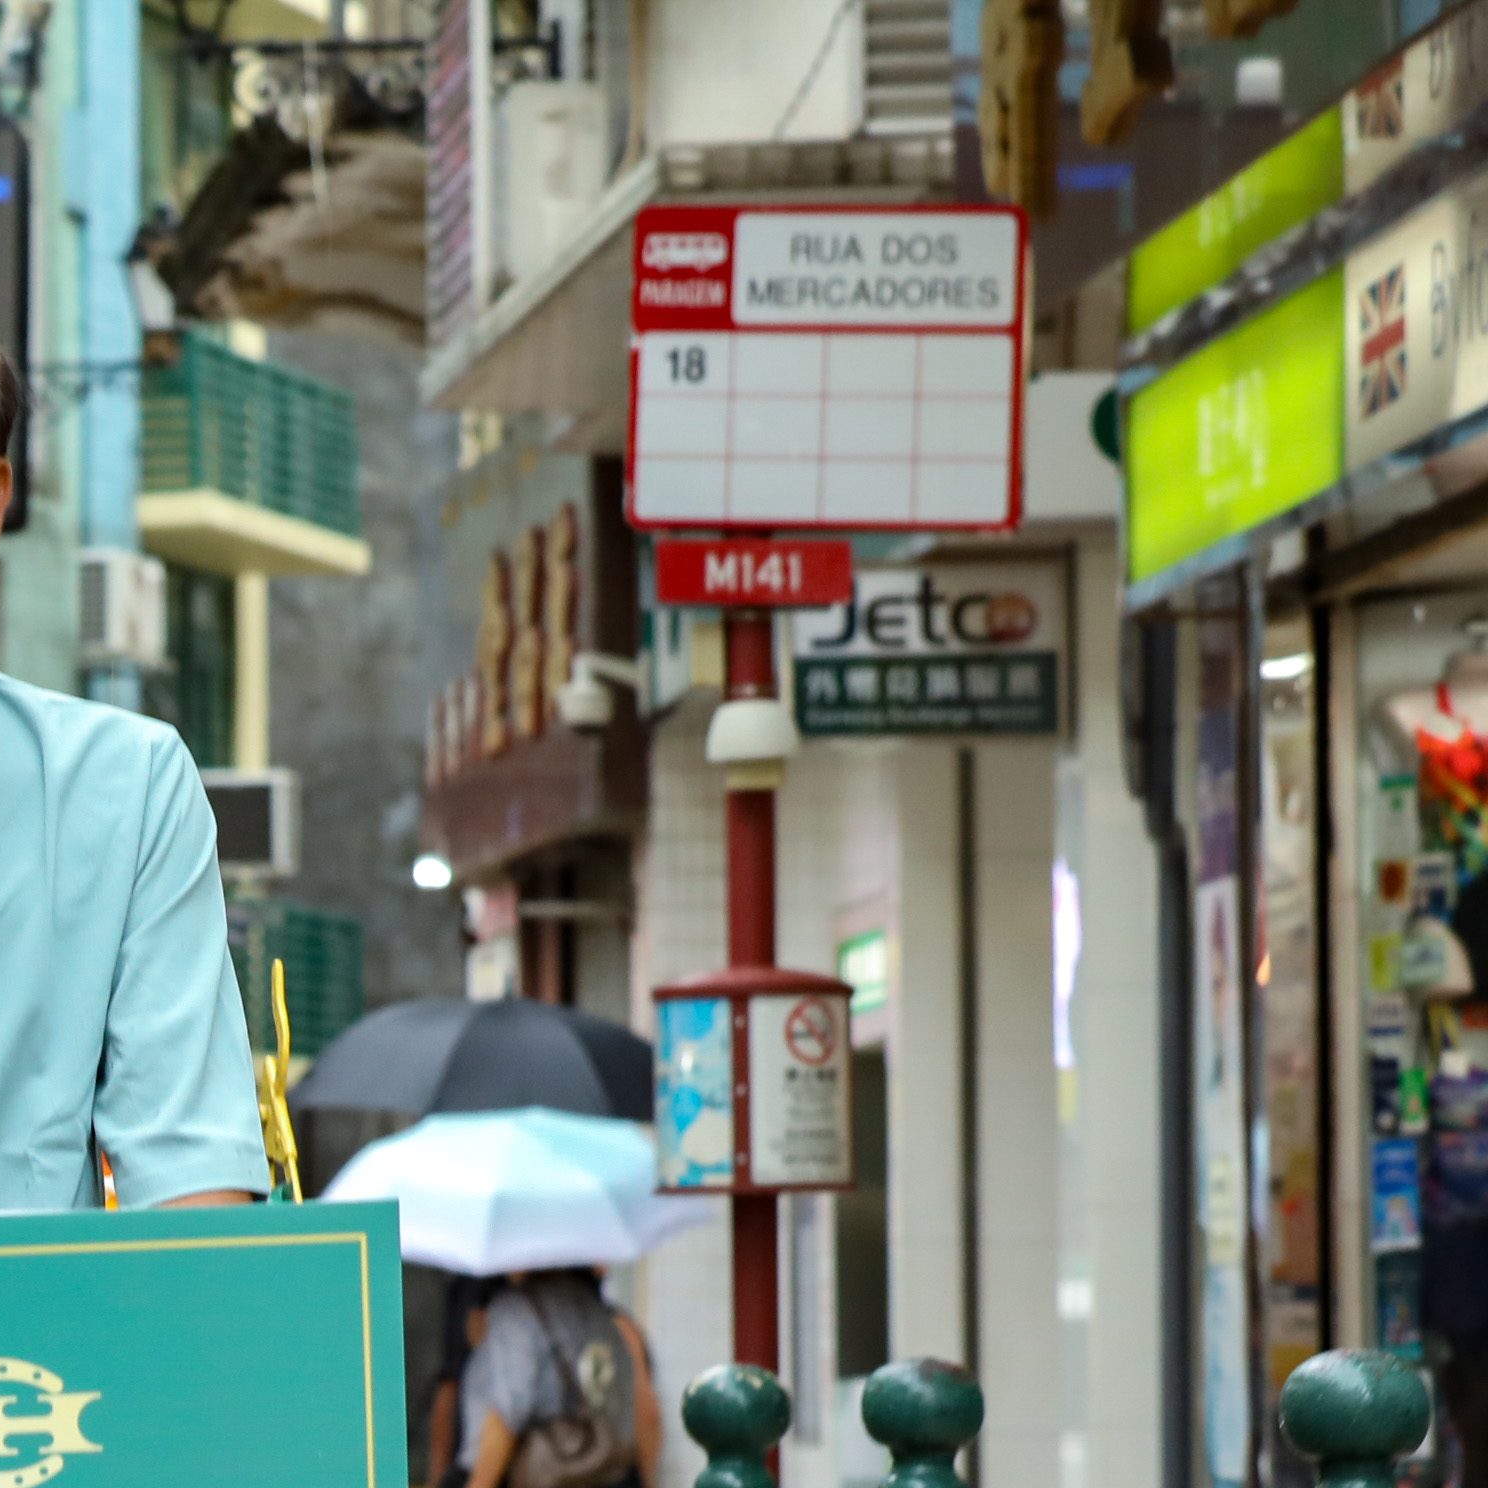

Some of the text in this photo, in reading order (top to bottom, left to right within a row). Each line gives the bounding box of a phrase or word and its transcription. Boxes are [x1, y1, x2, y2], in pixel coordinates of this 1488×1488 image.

[790, 232, 960, 266] RUA DOS
[747, 276, 1000, 309] MERCADORES
[665, 344, 707, 384] 18
[704, 551, 804, 594] M141
